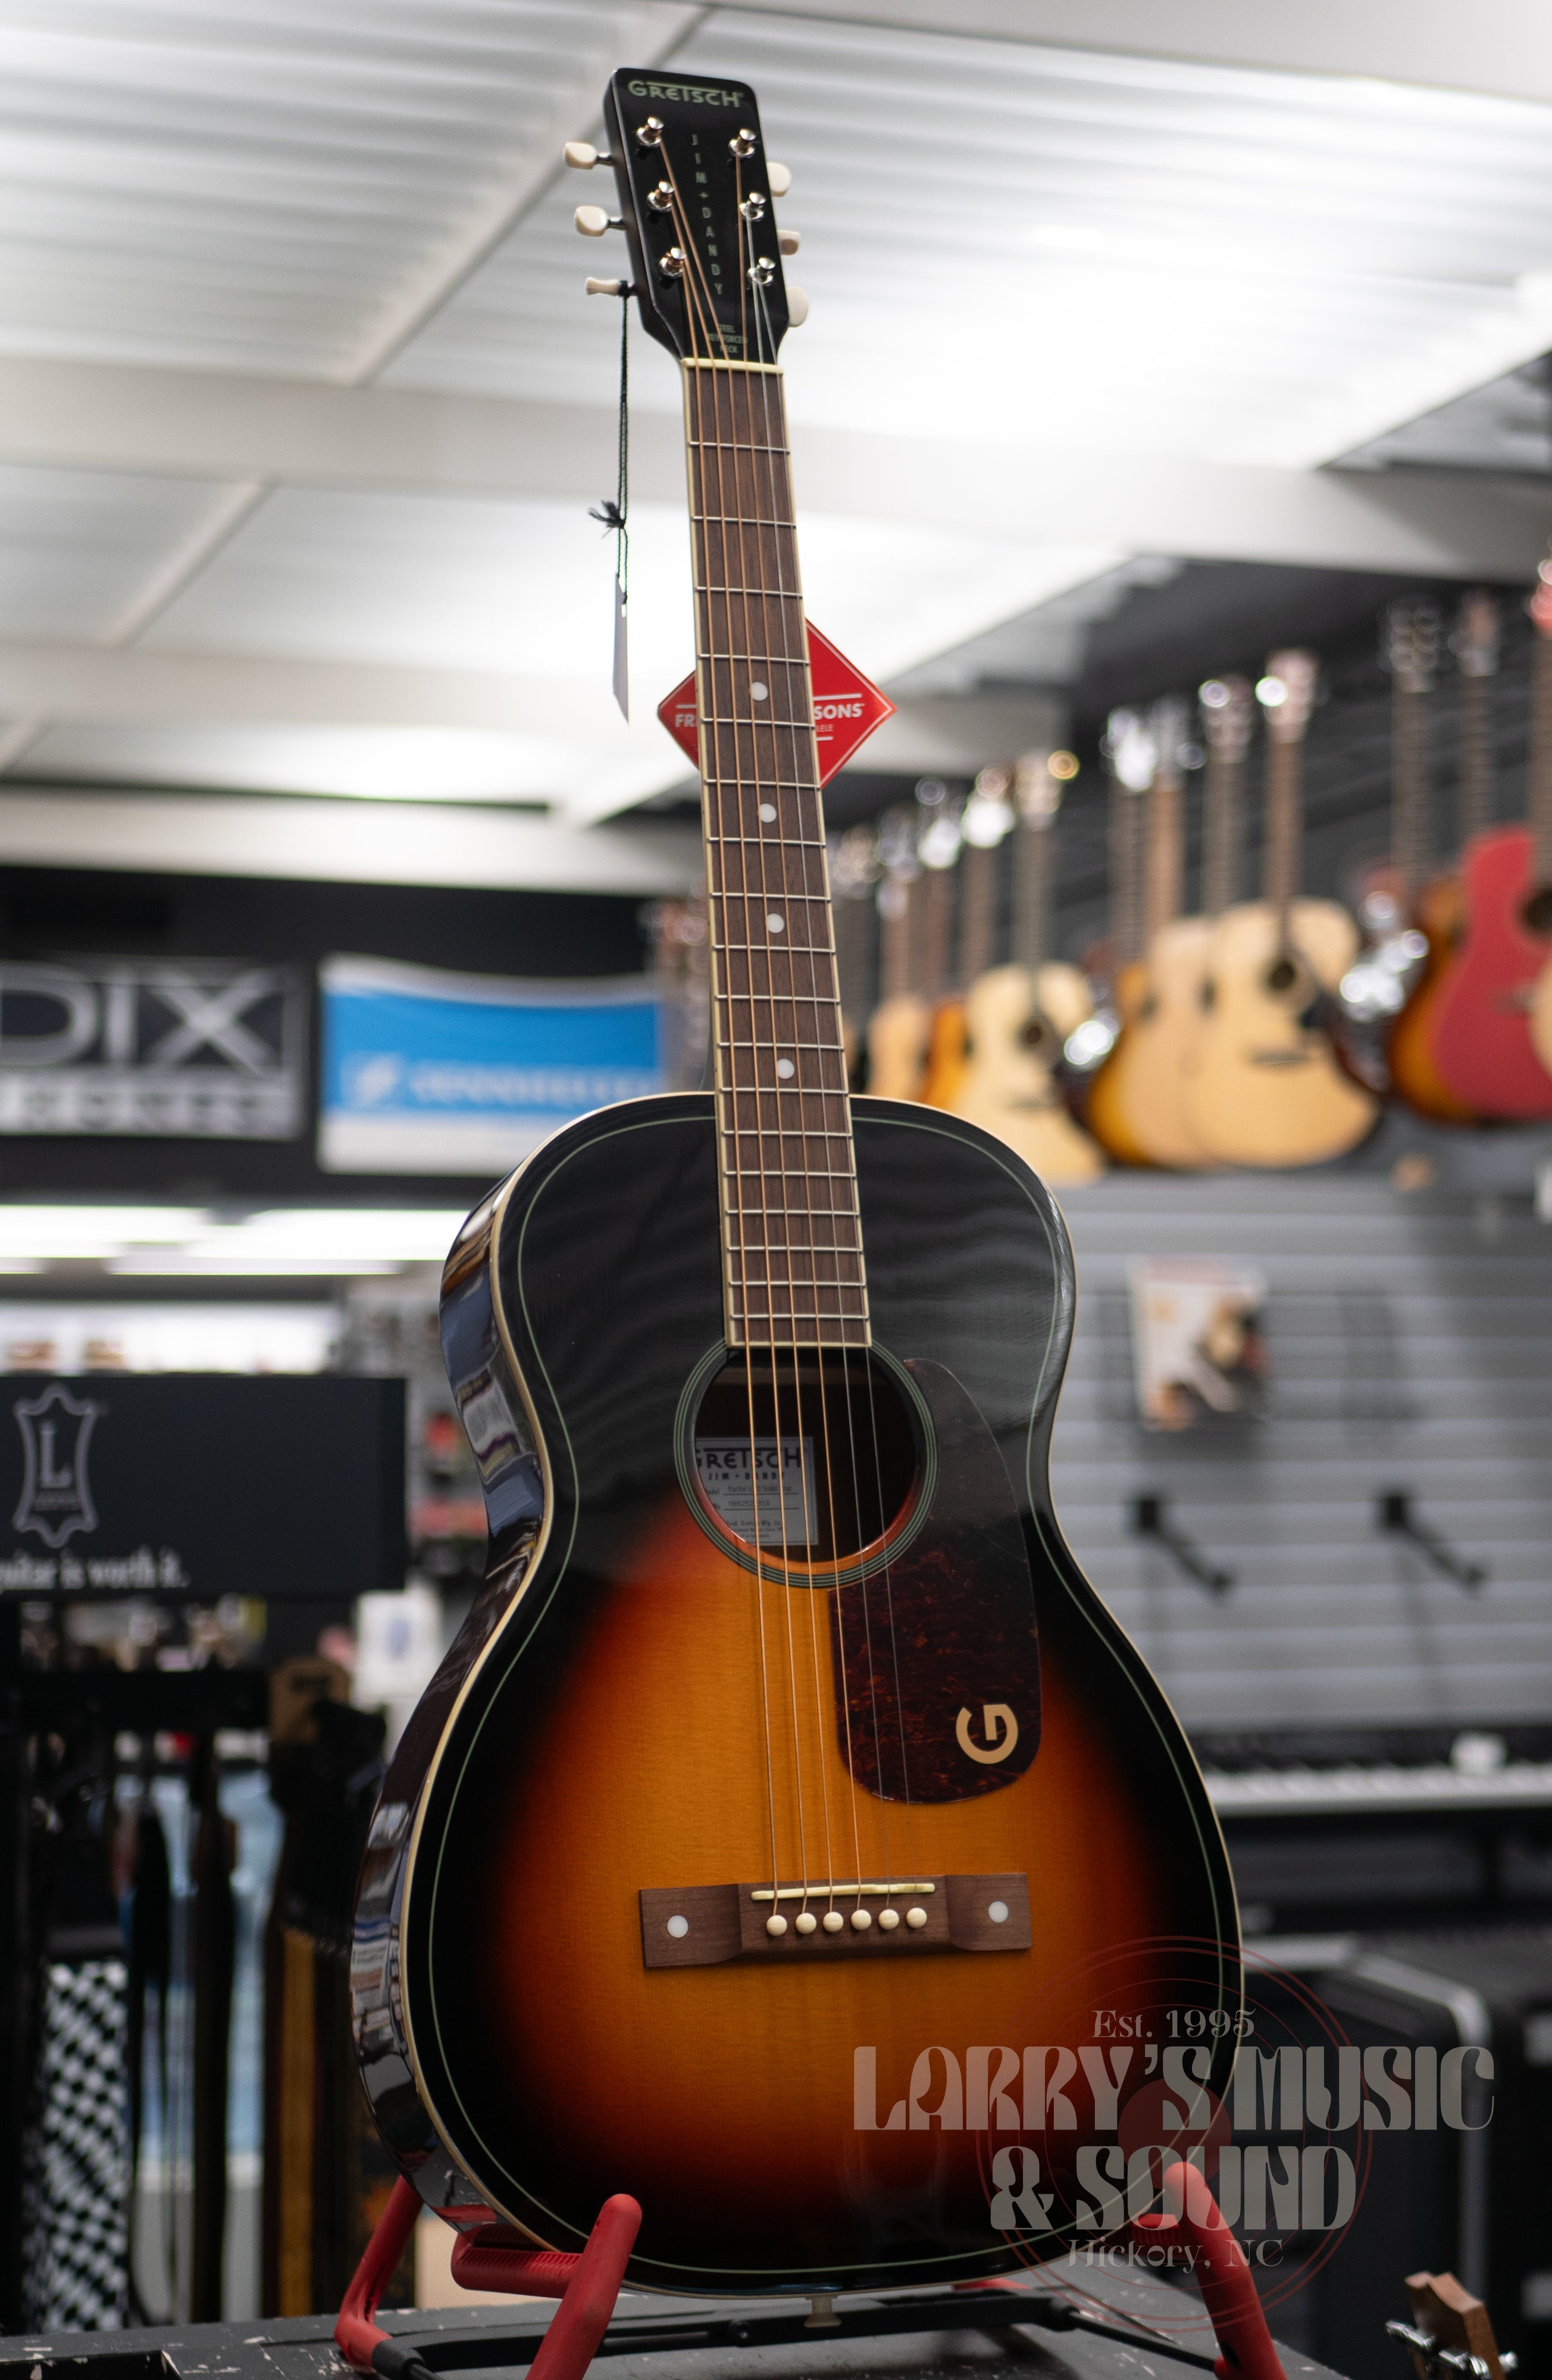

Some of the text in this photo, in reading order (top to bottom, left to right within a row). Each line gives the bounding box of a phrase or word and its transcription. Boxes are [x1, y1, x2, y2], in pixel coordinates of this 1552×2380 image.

[628, 80, 741, 108] GRETSCH
[716, 324, 736, 333] TEEL
[675, 703, 863, 728] FR SONS
